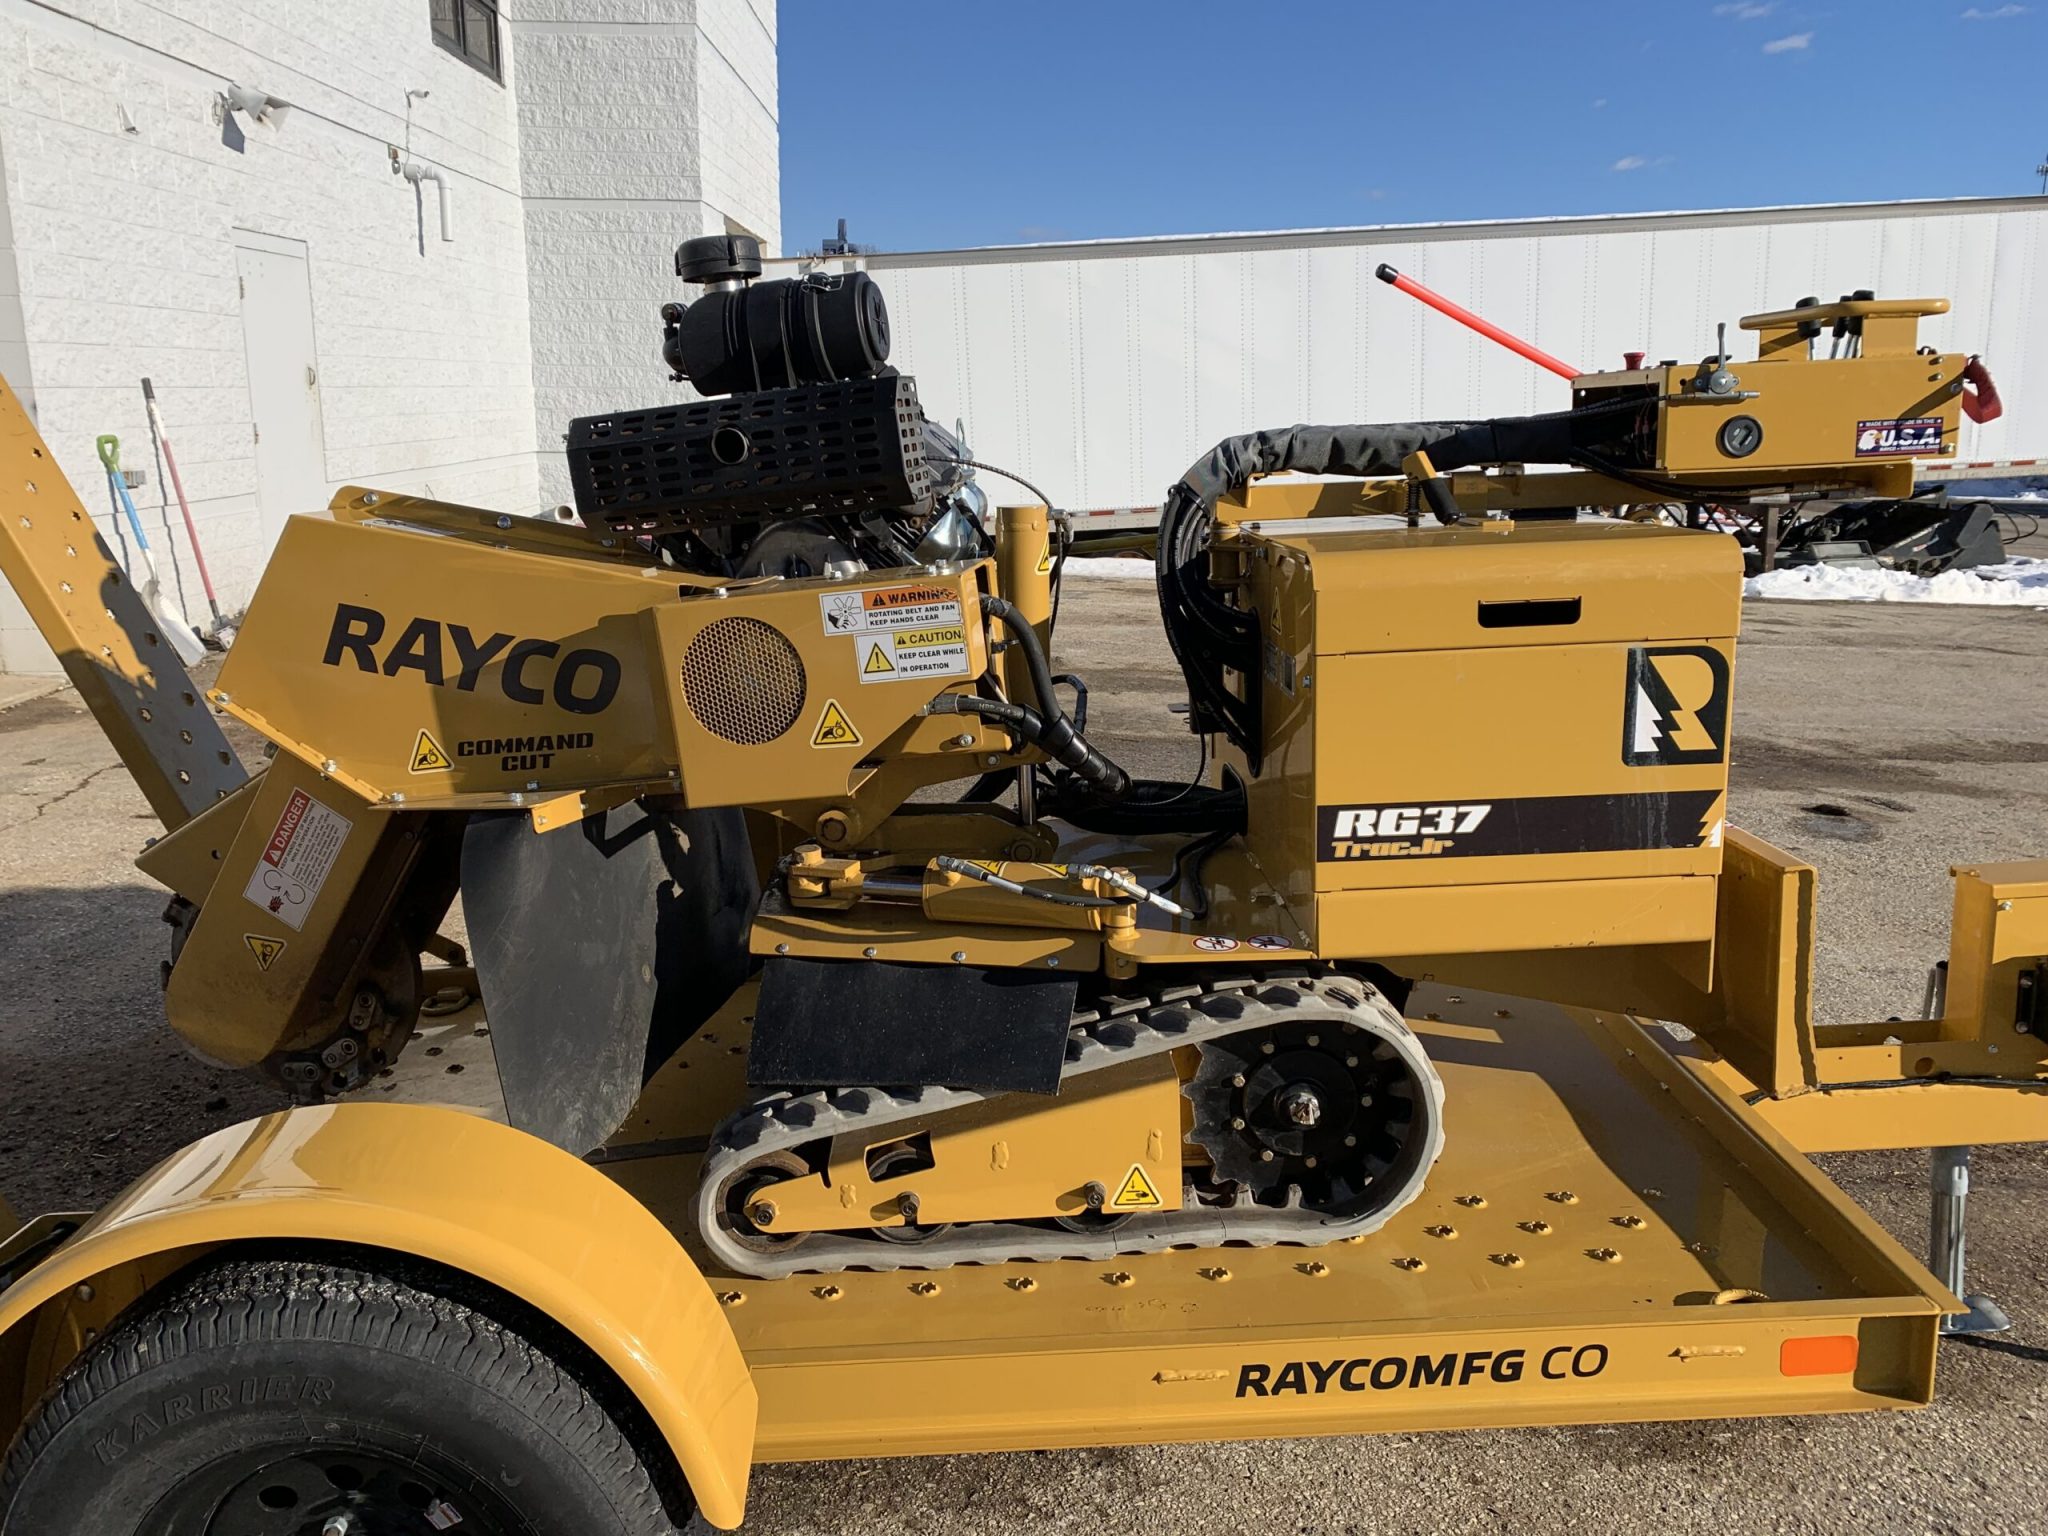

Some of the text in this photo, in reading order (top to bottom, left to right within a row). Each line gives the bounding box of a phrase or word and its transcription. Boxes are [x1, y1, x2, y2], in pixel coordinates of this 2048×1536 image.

[1880, 428, 1941, 446] U.S.A.
[869, 609, 903, 618] ROTATING
[890, 616, 914, 624] HANDS
[916, 614, 939, 622] CLEAR
[909, 630, 961, 644] CAUTION
[322, 603, 622, 715] RAYCO
[918, 650, 941, 658] CLEAR
[910, 662, 949, 671] OPERATION
[457, 732, 594, 757] COMMAND
[501, 753, 556, 772] CUT
[275, 797, 305, 848] DANGER
[1333, 804, 1492, 839] RG37
[1235, 1344, 1609, 1398] RAYCOMFG CO
[92, 1375, 335, 1466] KARRIER
